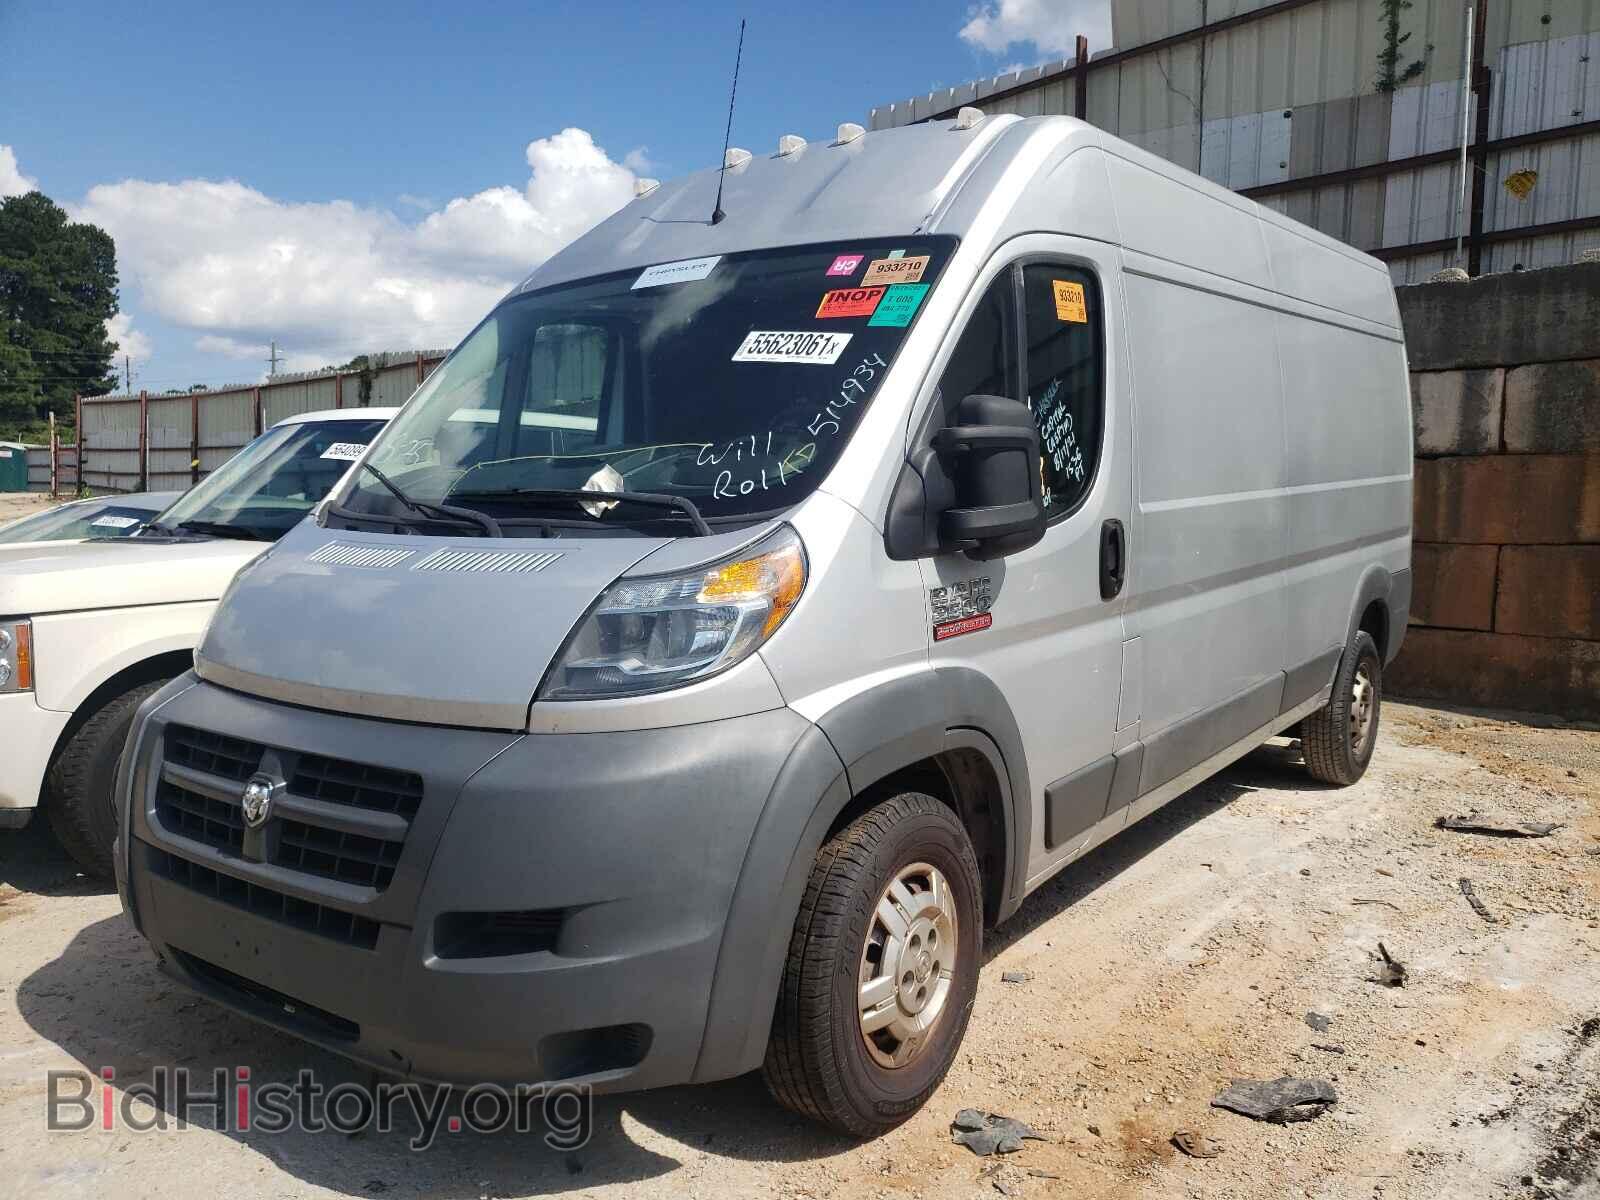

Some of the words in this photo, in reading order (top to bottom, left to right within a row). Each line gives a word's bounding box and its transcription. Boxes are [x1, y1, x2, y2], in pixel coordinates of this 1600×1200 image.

[876, 261, 922, 273] 933210
[827, 290, 883, 304] INOP
[697, 431, 773, 466] Will
